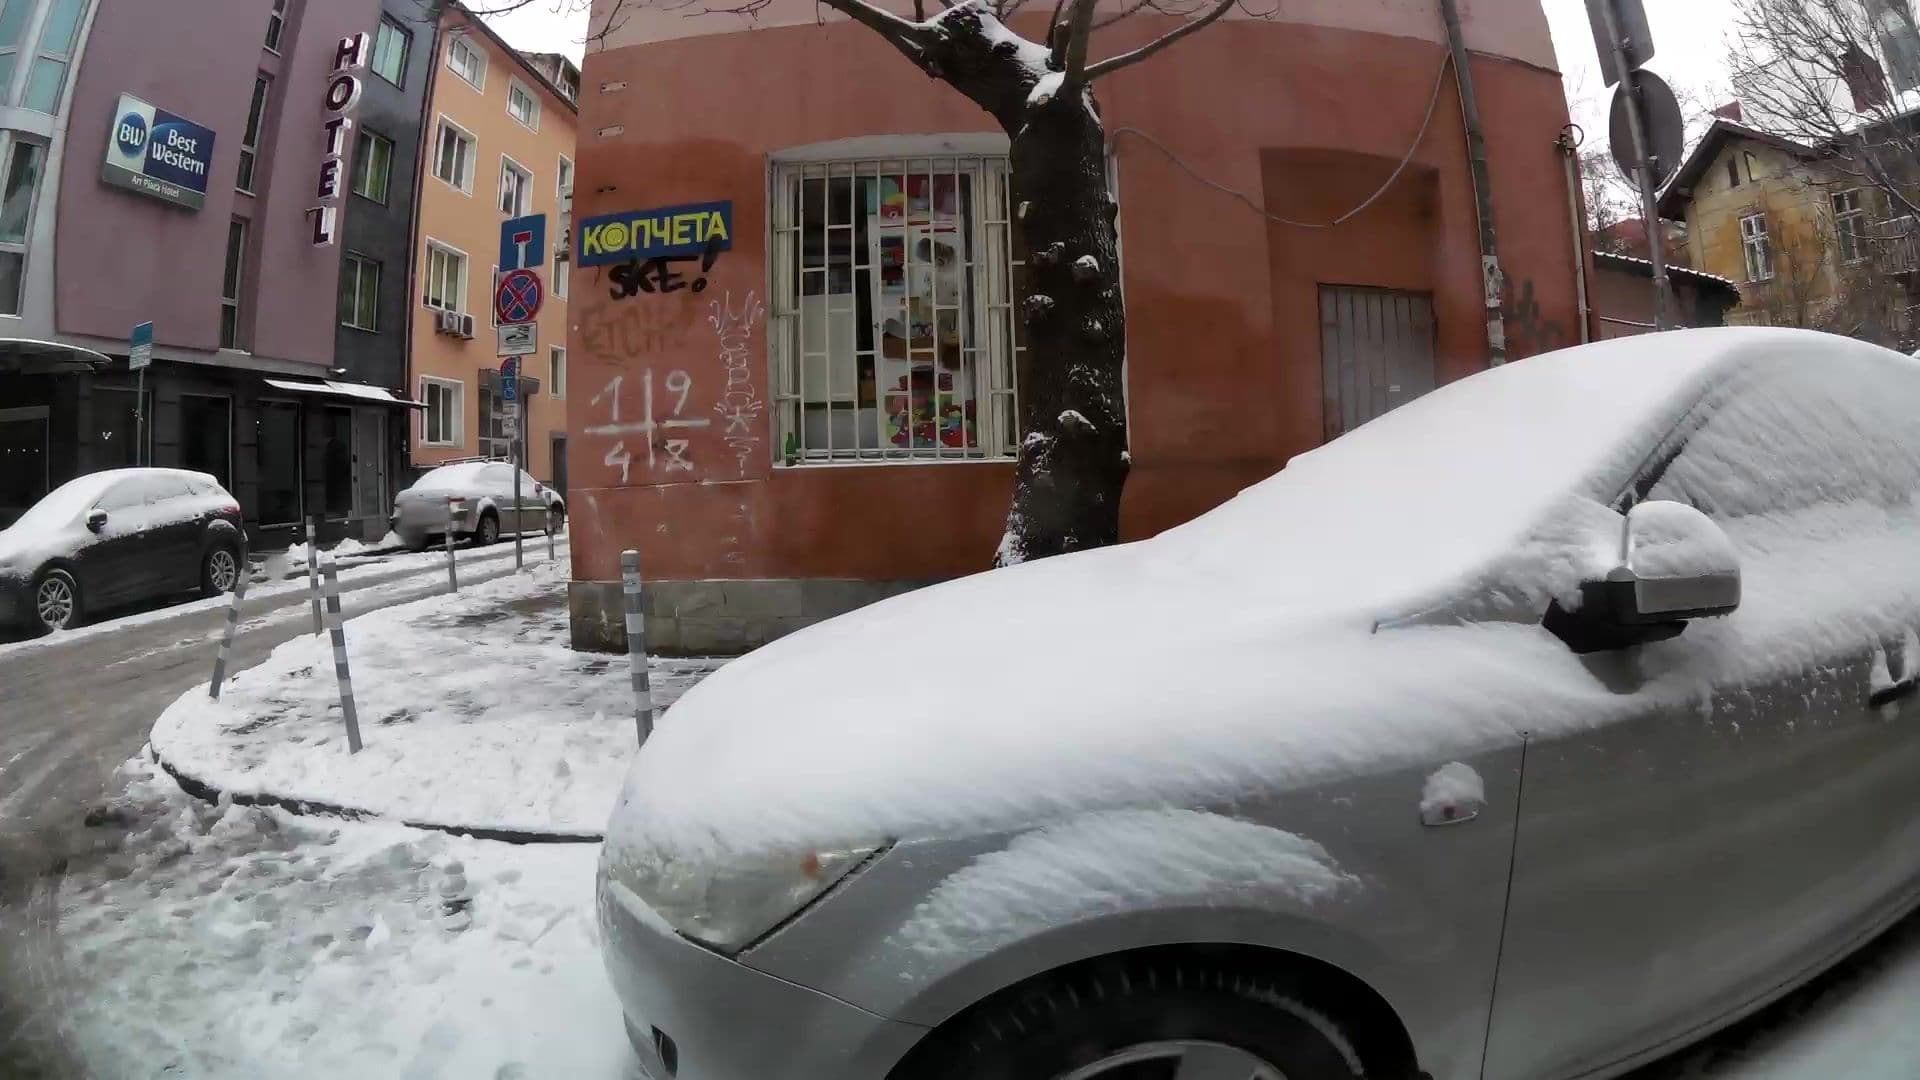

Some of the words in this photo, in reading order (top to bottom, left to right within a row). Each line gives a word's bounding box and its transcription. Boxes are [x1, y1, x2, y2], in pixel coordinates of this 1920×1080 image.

[119, 123, 146, 147] BW
[167, 128, 198, 155] Best
[313, 32, 369, 247] HOTEL
[151, 141, 205, 176] Western
[160, 182, 181, 199] Hotel
[583, 210, 729, 257] КОПЧЕТА
